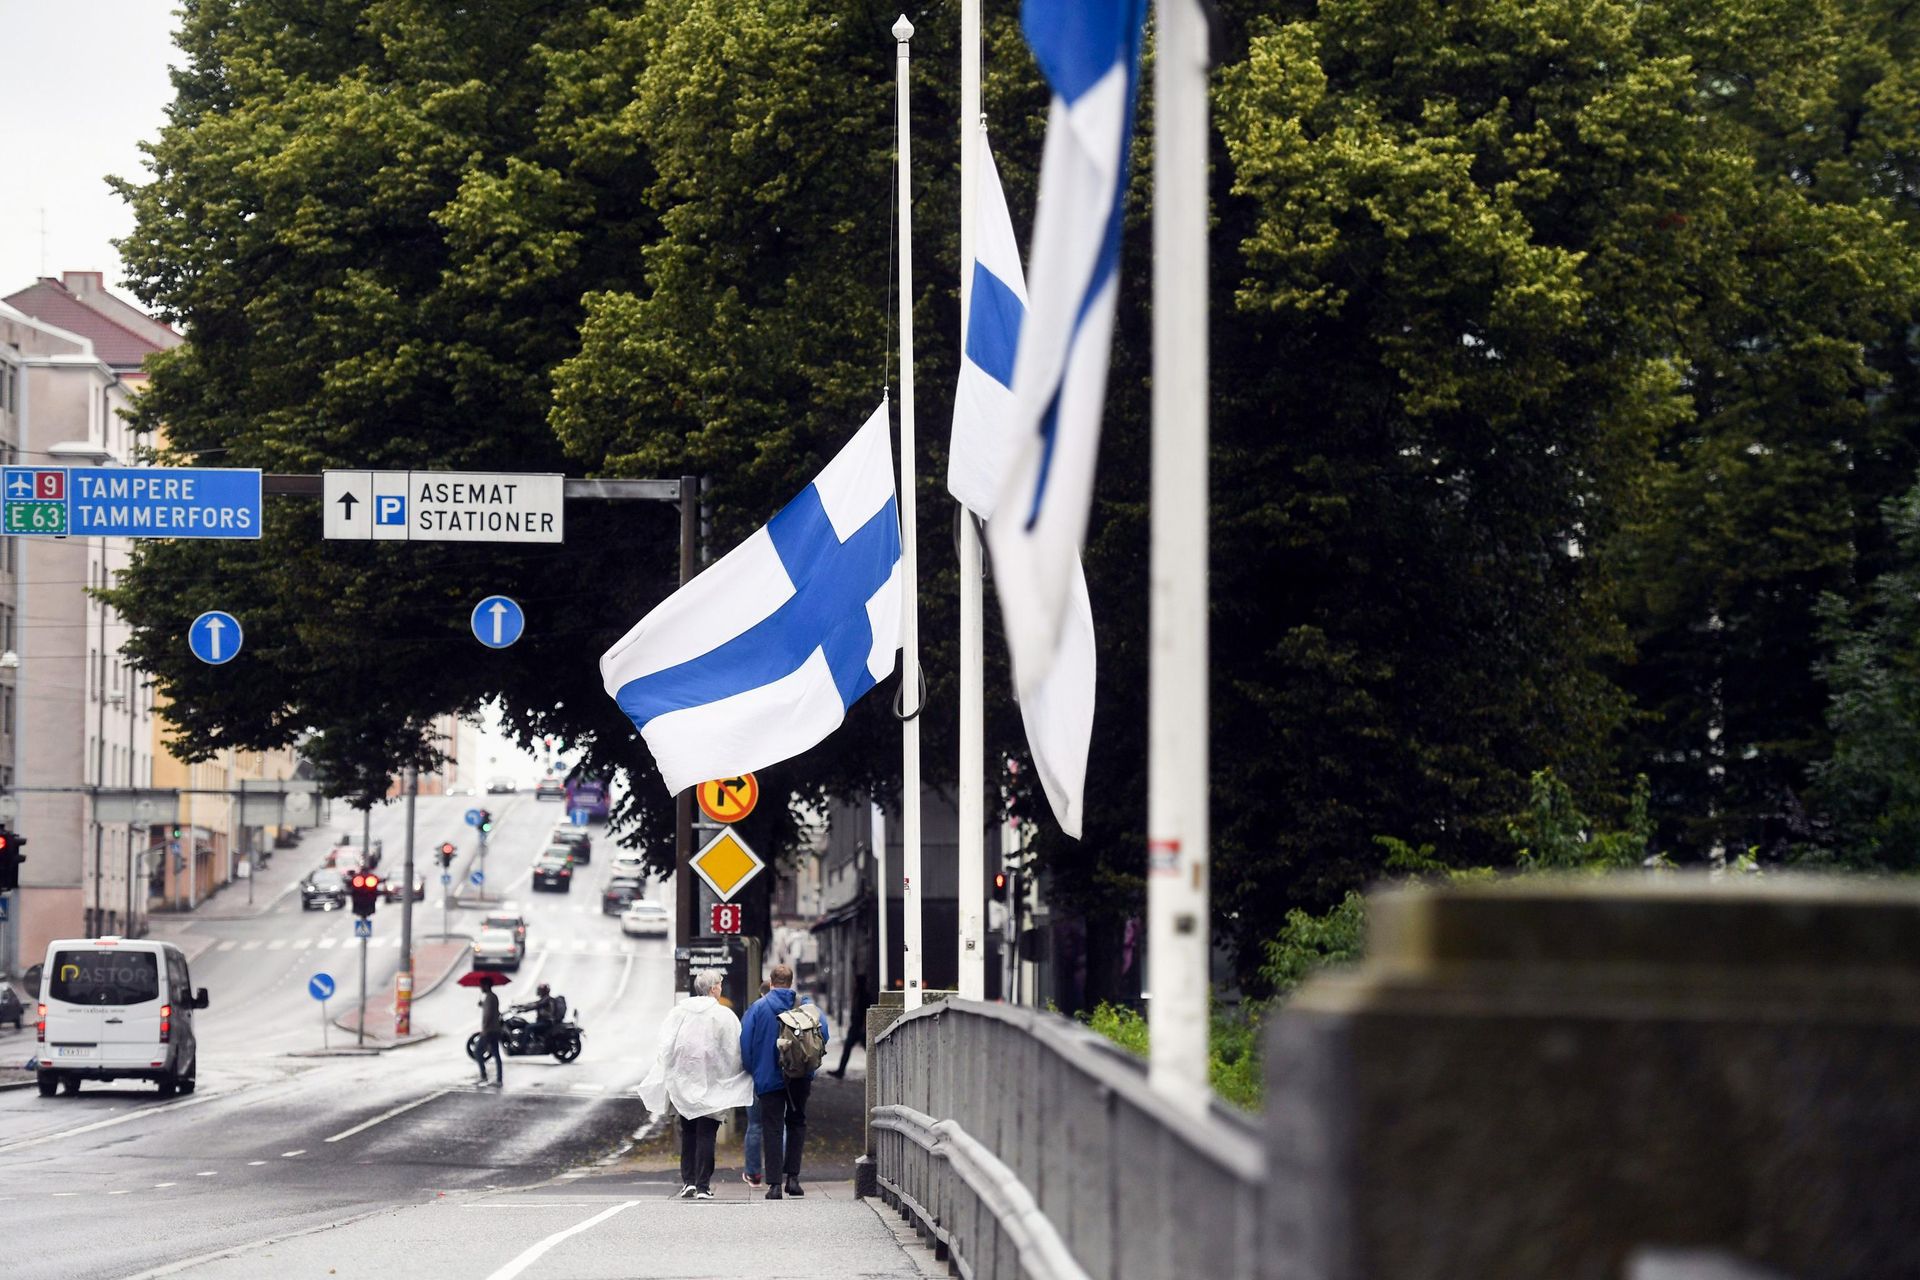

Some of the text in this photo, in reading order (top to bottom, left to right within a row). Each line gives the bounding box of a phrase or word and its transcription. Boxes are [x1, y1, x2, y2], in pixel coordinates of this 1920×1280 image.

[43, 475, 57, 496] 9
[78, 477, 195, 500] TAMPERE
[419, 483, 517, 504] ASEMAT
[12, 506, 59, 528] E 63
[78, 505, 251, 529] TAMMERFORS
[381, 497, 401, 523] P
[419, 510, 554, 533] STATIONER
[719, 908, 732, 930] 8
